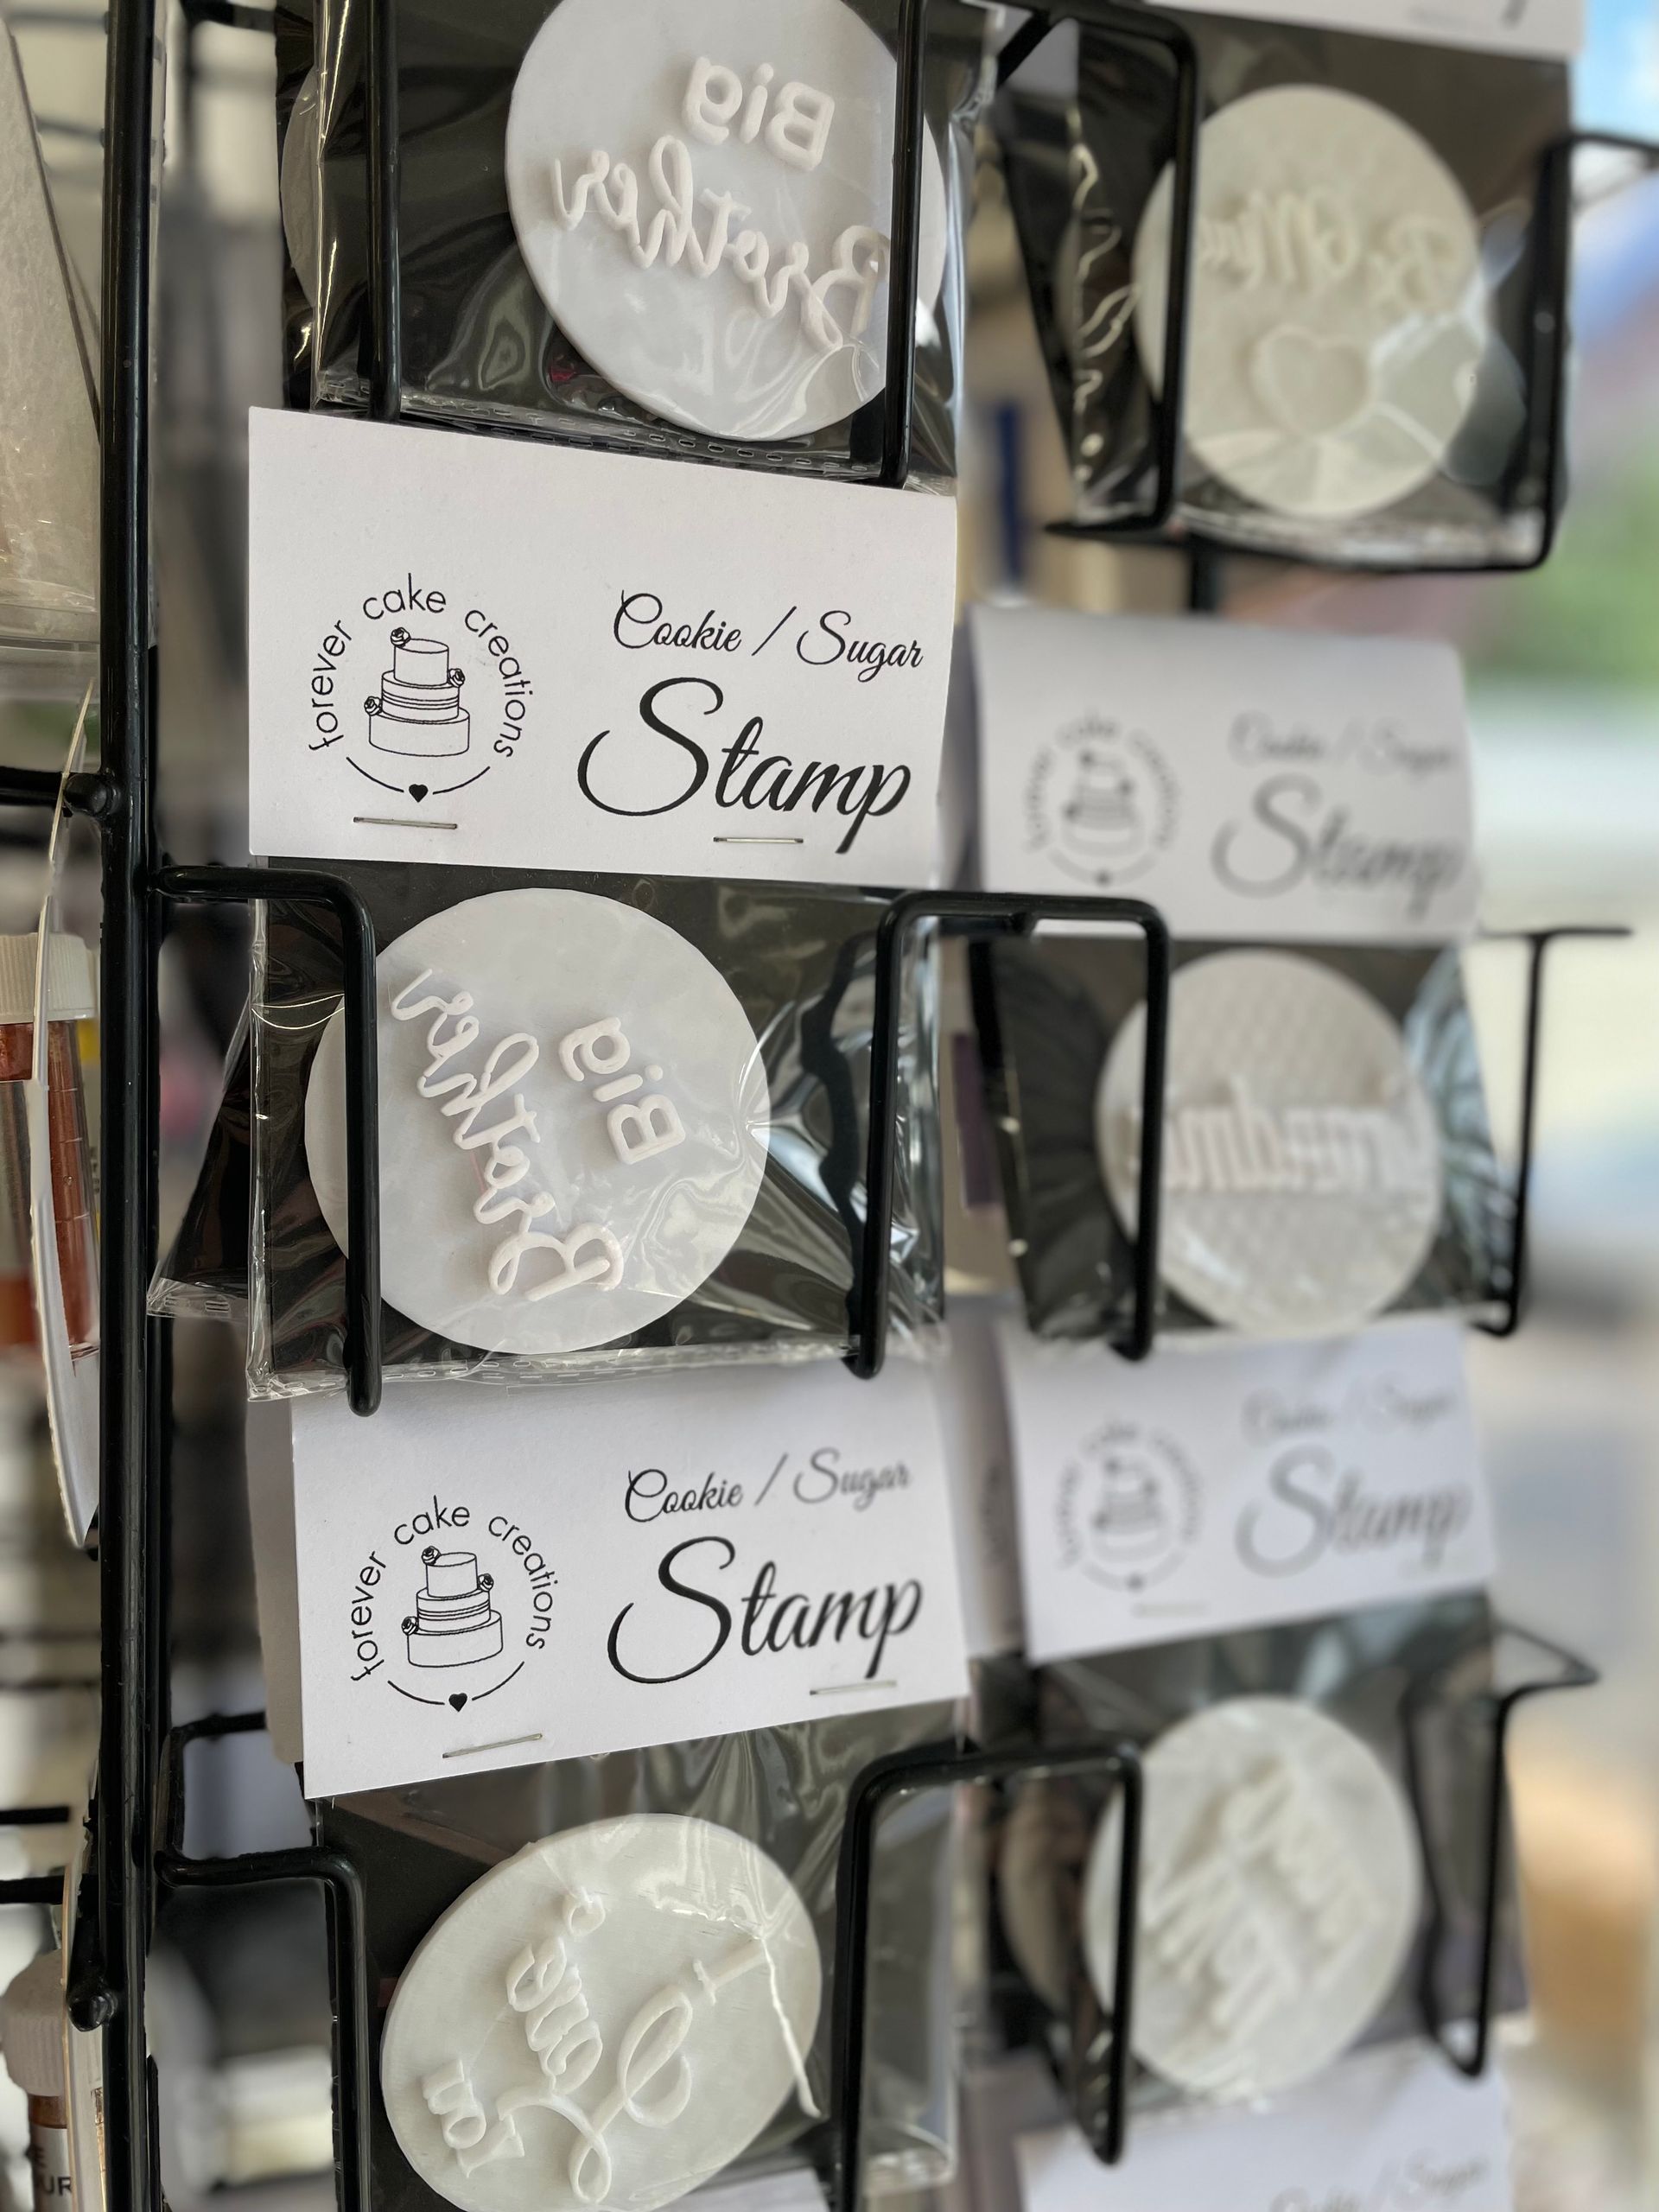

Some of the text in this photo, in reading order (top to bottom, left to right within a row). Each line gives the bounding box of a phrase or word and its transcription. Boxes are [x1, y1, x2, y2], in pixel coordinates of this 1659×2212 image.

[308, 572, 534, 758] forever cake creations
[613, 589, 924, 683] Cookie / Sugar
[577, 677, 911, 855] Stamp
[625, 1447, 912, 1522] Cookie / Sugar
[350, 1495, 558, 1681] forever cake creations
[607, 1535, 924, 1684] Stamp
